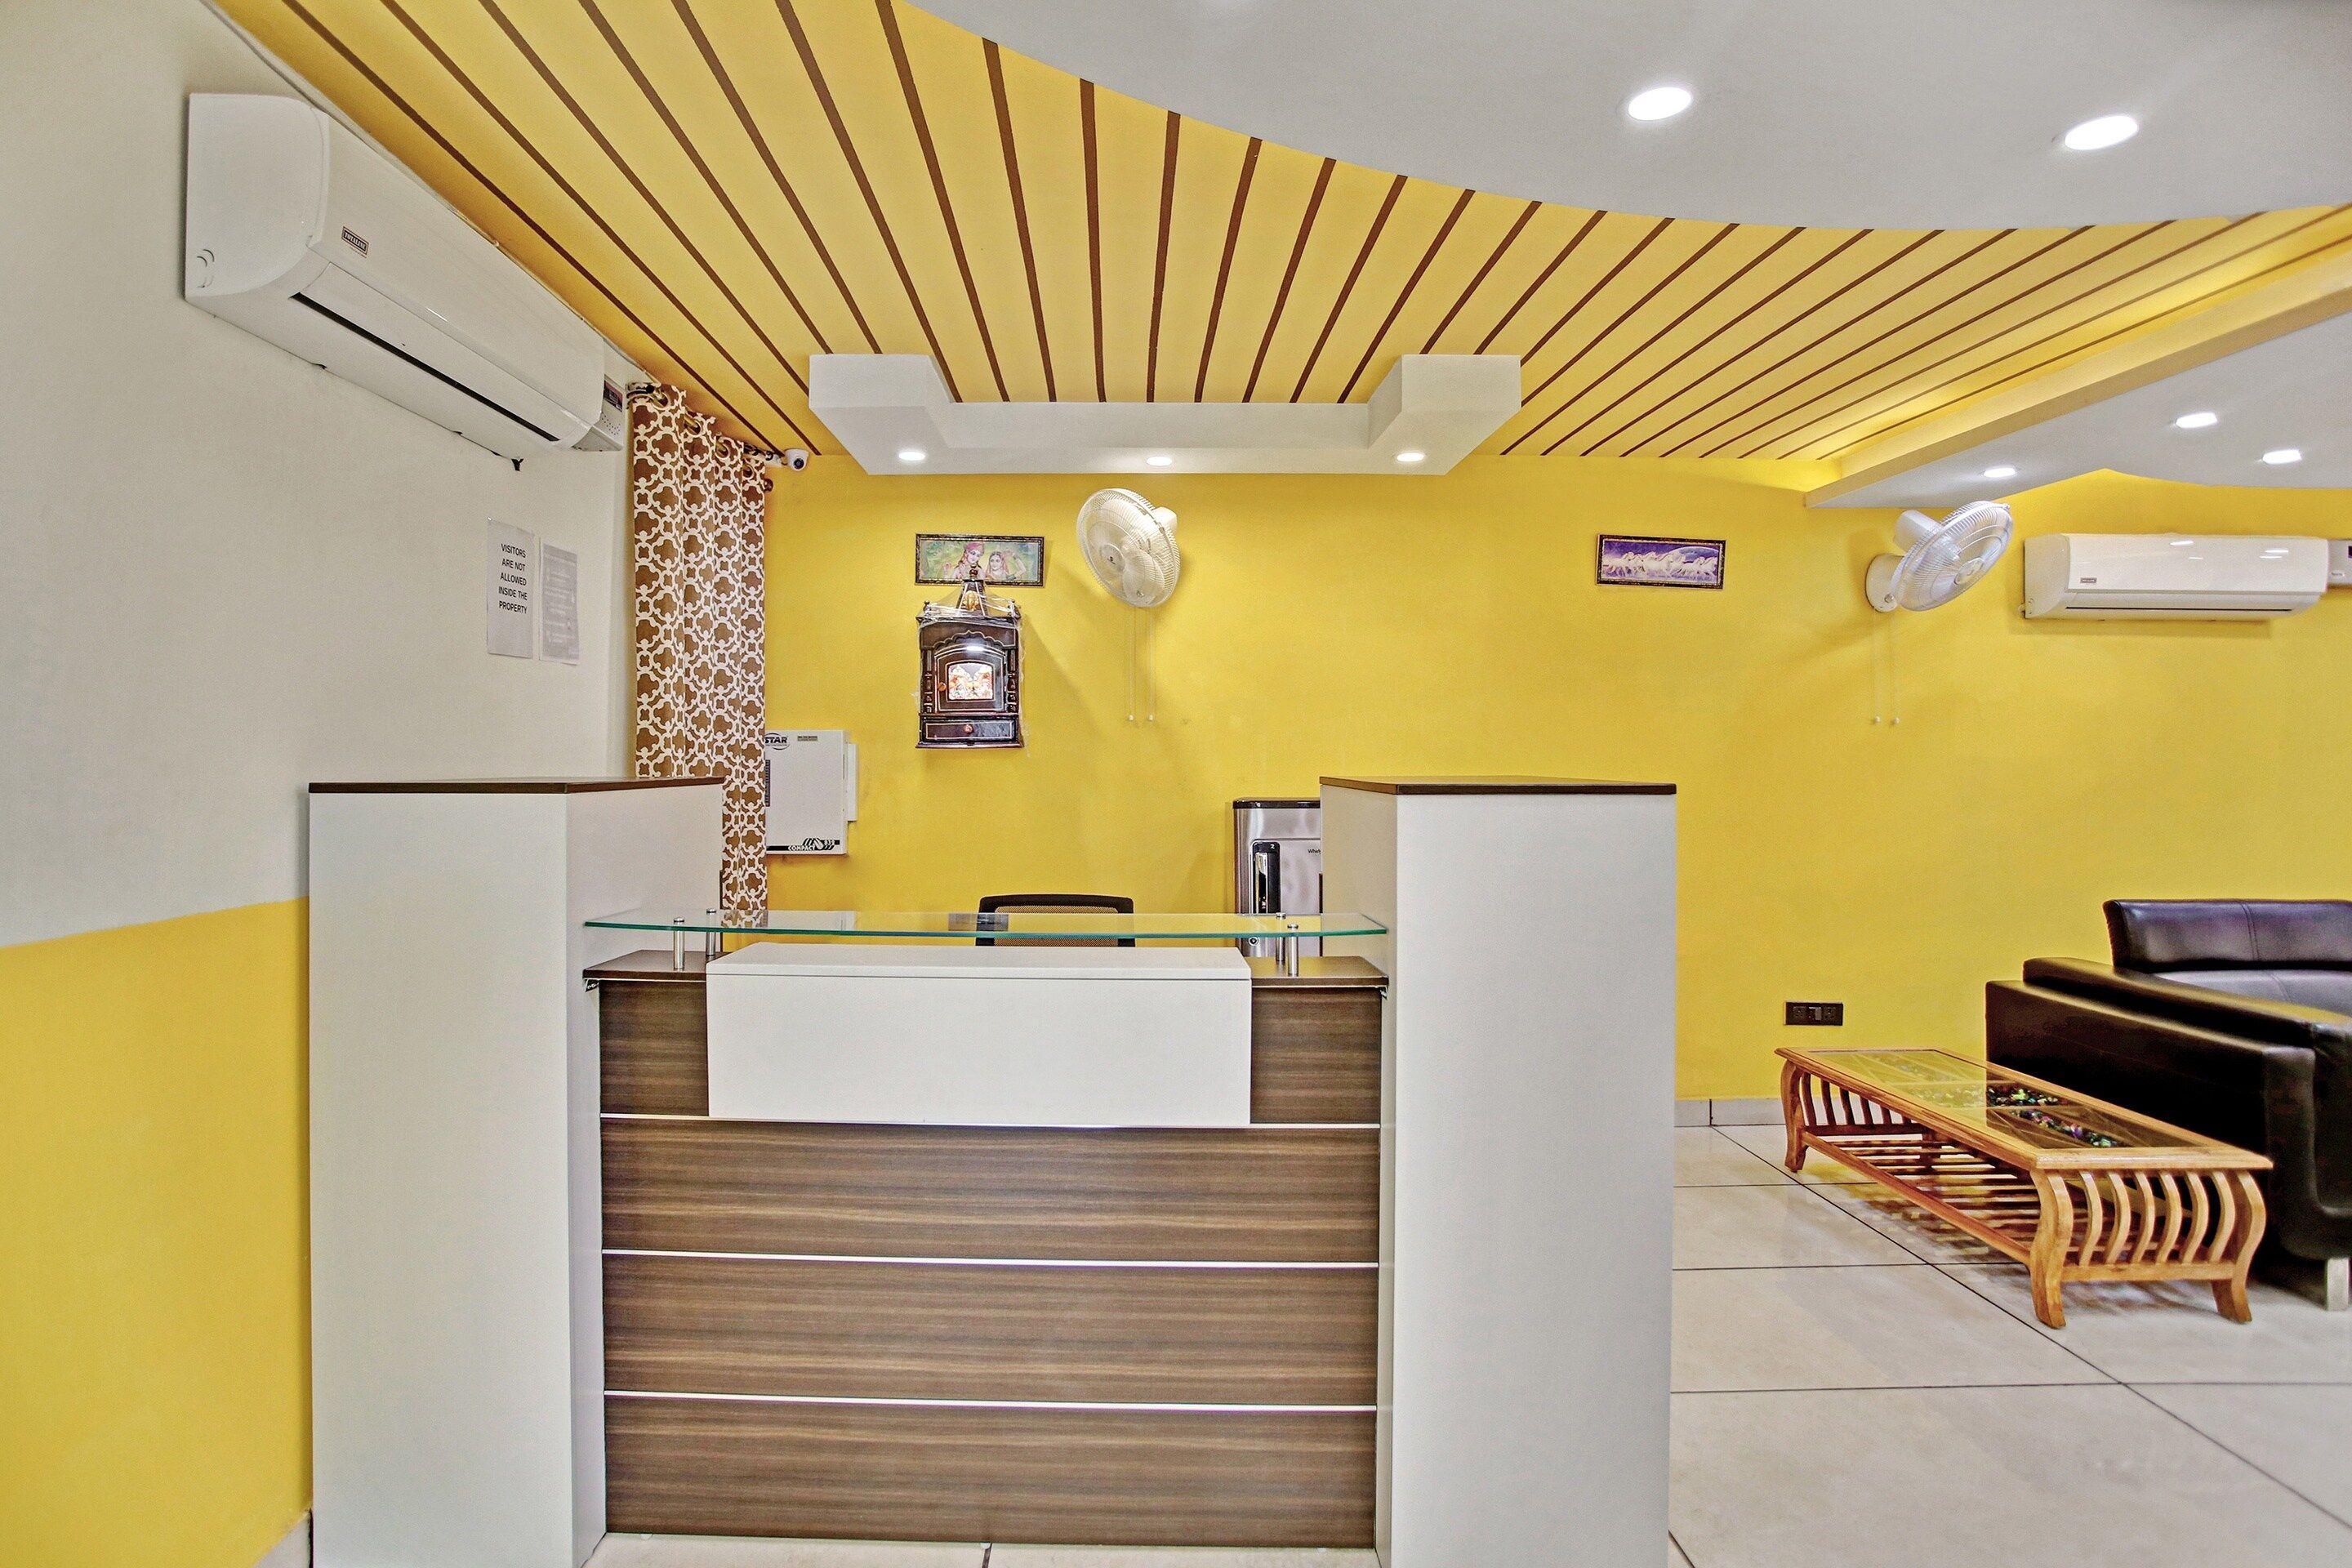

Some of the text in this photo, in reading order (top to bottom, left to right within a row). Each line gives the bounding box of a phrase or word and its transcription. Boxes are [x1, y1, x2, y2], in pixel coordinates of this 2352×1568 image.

[501, 543, 527, 559] VISITORS
[501, 558, 526, 572] ARE NOT
[500, 572, 527, 586] ALLOWED
[498, 586, 528, 600] INSIDE THE
[498, 600, 528, 614] PROPERTY
